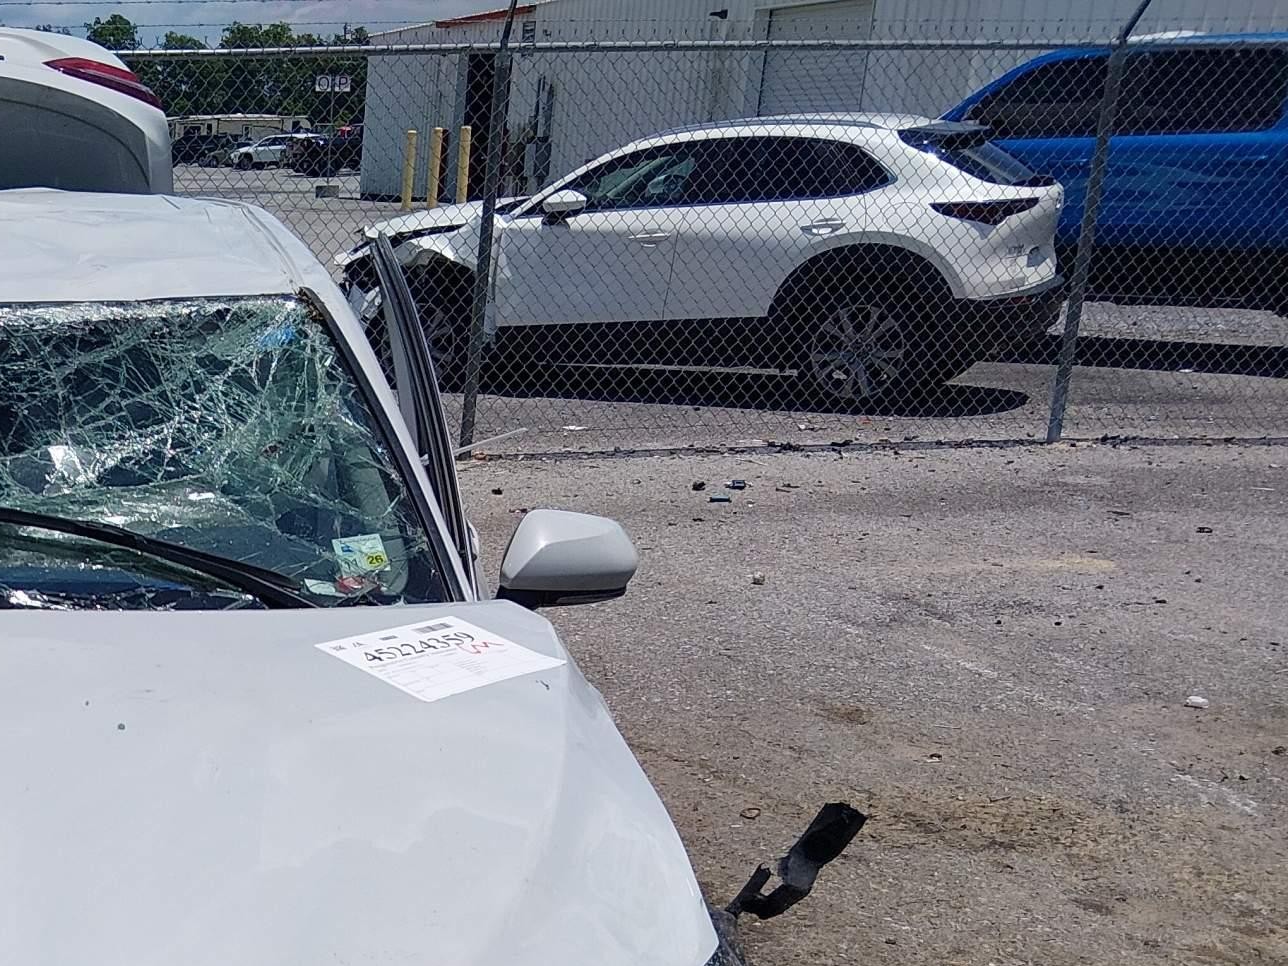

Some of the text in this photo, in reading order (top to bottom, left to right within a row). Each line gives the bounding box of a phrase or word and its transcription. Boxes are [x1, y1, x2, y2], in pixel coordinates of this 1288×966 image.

[338, 76, 348, 91] P
[367, 555, 384, 565] 26
[364, 631, 475, 663] 45224359
